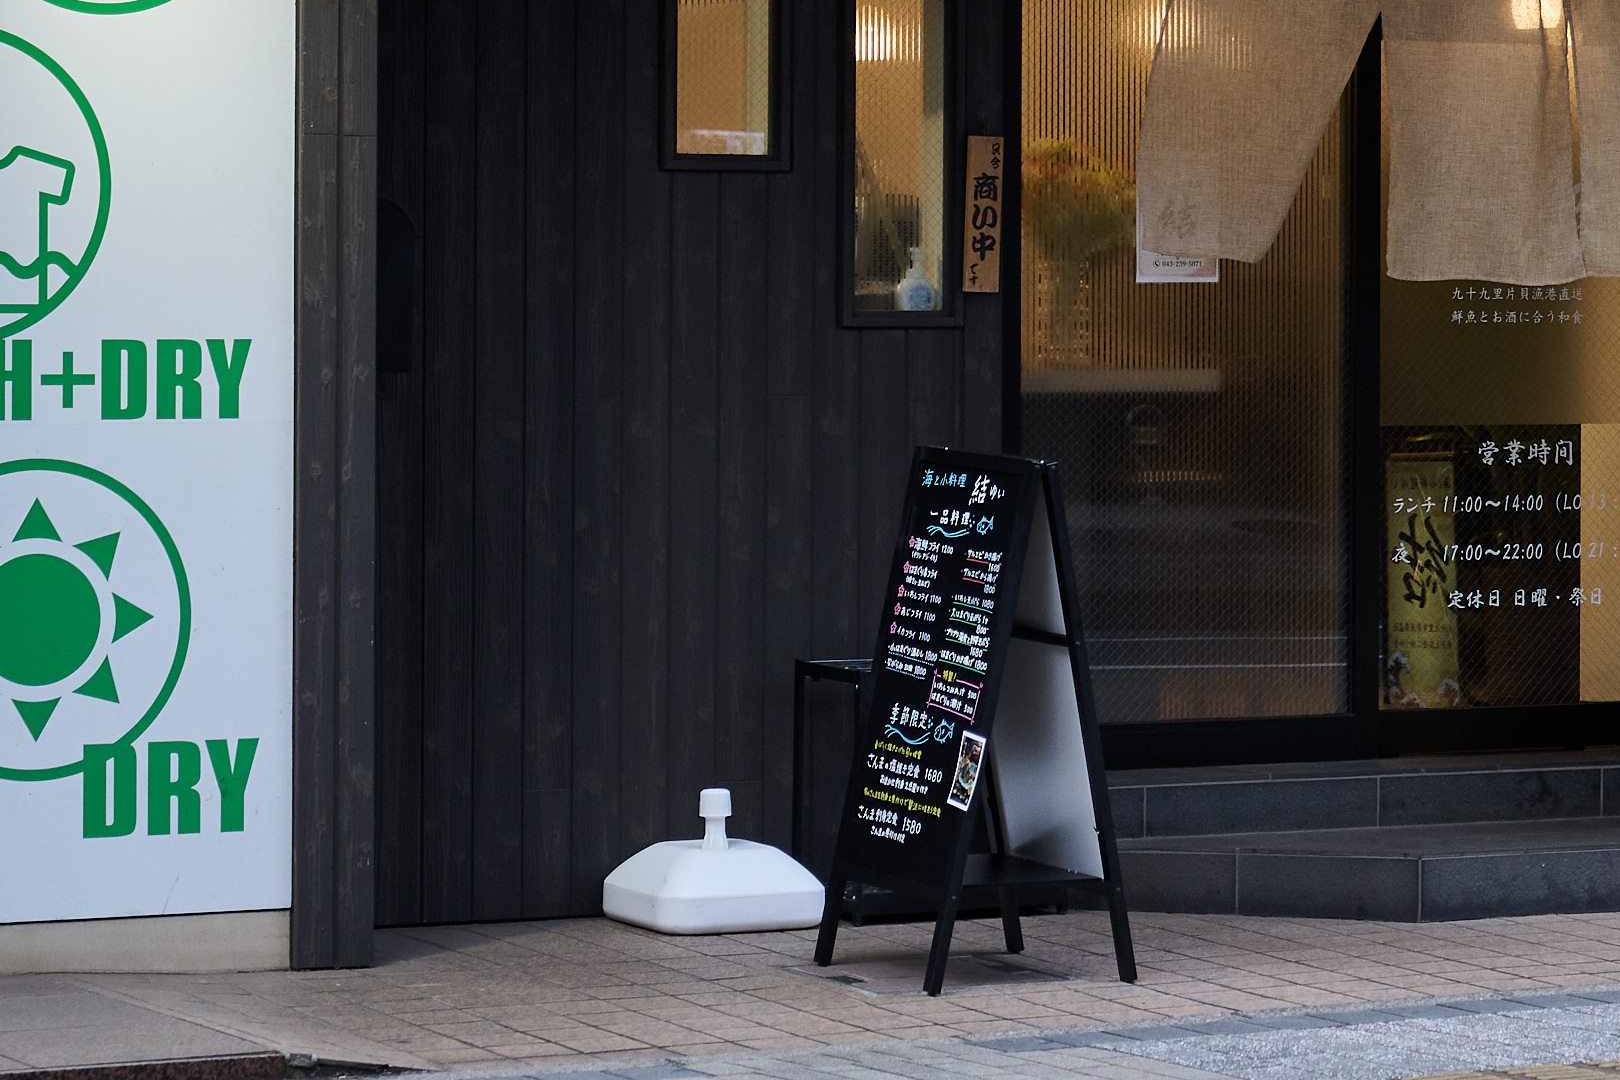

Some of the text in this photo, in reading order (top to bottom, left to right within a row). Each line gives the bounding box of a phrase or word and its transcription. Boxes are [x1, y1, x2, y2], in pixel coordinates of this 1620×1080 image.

[1451, 286, 1584, 301] 九十九里片貝漁港直送
[1450, 309, 1584, 324] 鮮魚とお酒に合う和食
[1477, 438, 1574, 467] 営業時間
[921, 468, 1005, 506] 海と小料理 結 ゆい
[1392, 496, 1436, 514] ランチ
[929, 508, 971, 527] 一品料理
[1391, 542, 1411, 565] 夜
[1446, 586, 1603, 610] 定休日 日曜・祭日
[889, 702, 928, 730] 季節限定
[924, 767, 943, 783] 1680
[82, 736, 260, 840] DRY
[901, 816, 922, 835] 1580
